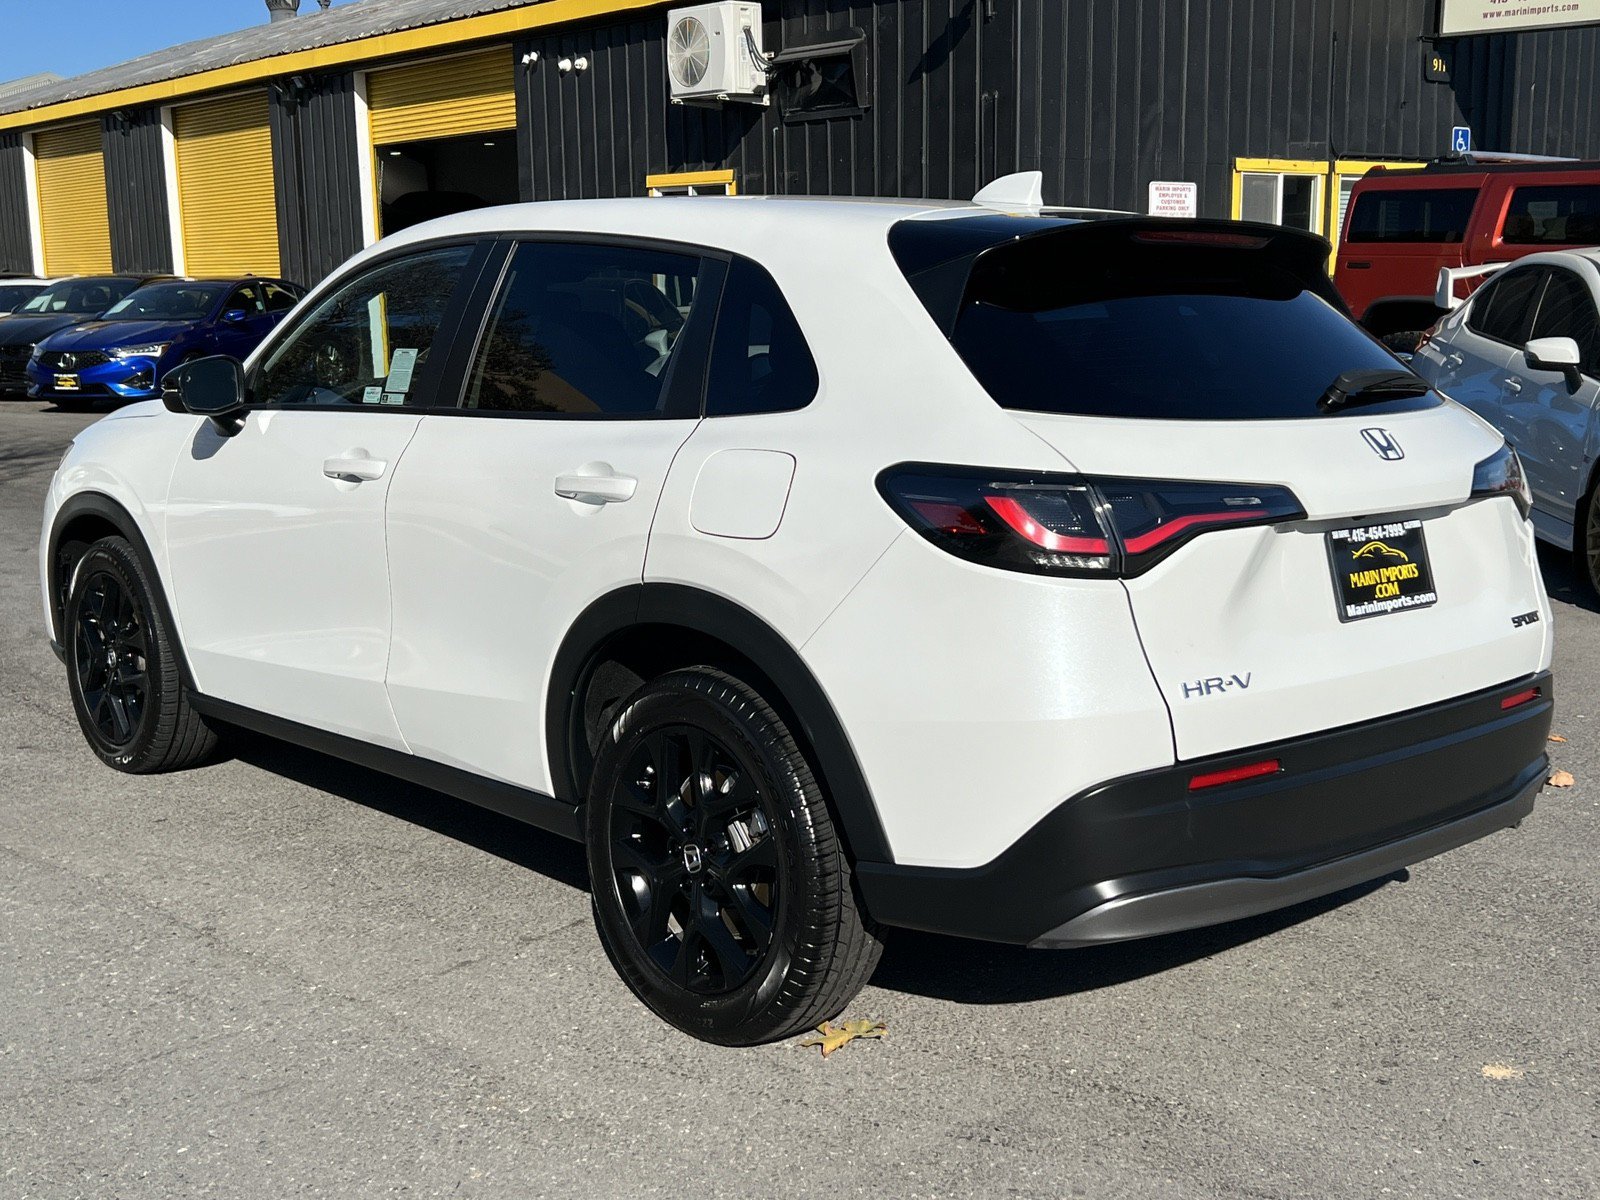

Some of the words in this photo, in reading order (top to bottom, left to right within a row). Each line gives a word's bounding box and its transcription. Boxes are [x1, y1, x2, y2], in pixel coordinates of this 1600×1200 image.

[1482, 3, 1579, 19] www.marinimports.com
[1352, 523, 1404, 542] 415-454-7999
[1350, 569, 1380, 588] MARIN
[1381, 563, 1419, 582] IMPORTS
[1374, 581, 1400, 599] .COM
[1346, 592, 1436, 617] MarinImports.com
[1511, 610, 1539, 628] SPORT
[1181, 672, 1251, 698] HR-V
